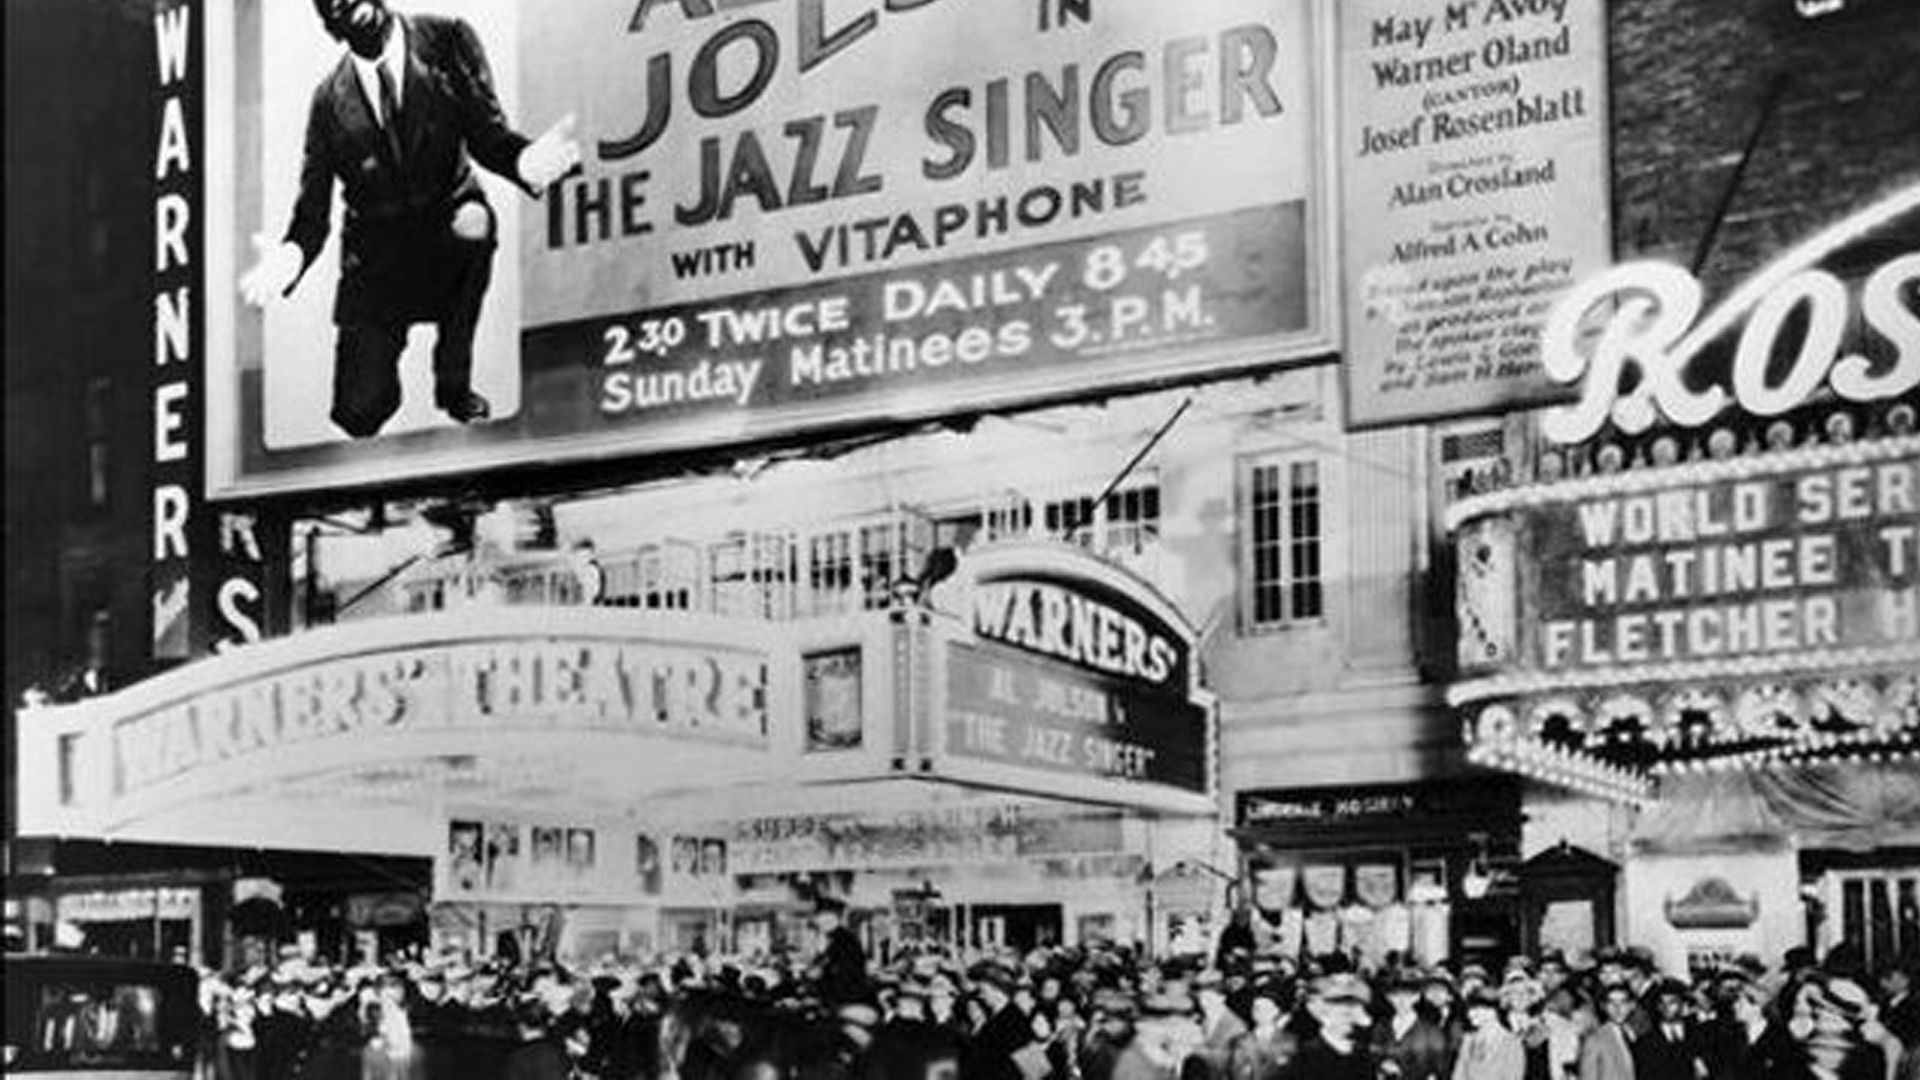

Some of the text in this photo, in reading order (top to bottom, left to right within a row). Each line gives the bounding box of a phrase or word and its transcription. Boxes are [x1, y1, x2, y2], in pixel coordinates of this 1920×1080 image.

[1371, 16, 1433, 49] May
[1372, 25, 1570, 89] Warner Oland
[597, 0, 936, 160] JOL
[544, 24, 1284, 250] THE JAZZ SINGER
[1358, 88, 1585, 158] Josef Rosenblatt
[672, 171, 1147, 278] WITH VITAPHONE
[1388, 159, 1556, 208] Alan Crosland
[1461, 232, 1480, 252] A
[1485, 222, 1549, 250] Cohn
[697, 298, 850, 348] TWICE
[883, 258, 1060, 322] DAILY
[600, 358, 762, 412] Sunday
[790, 318, 1033, 386] Matinees
[1579, 463, 1917, 547] WORLD SER
[1582, 526, 1914, 607] MATINEE T
[1543, 597, 1838, 667] FLETCHER
[458, 646, 768, 736] THEATRE
